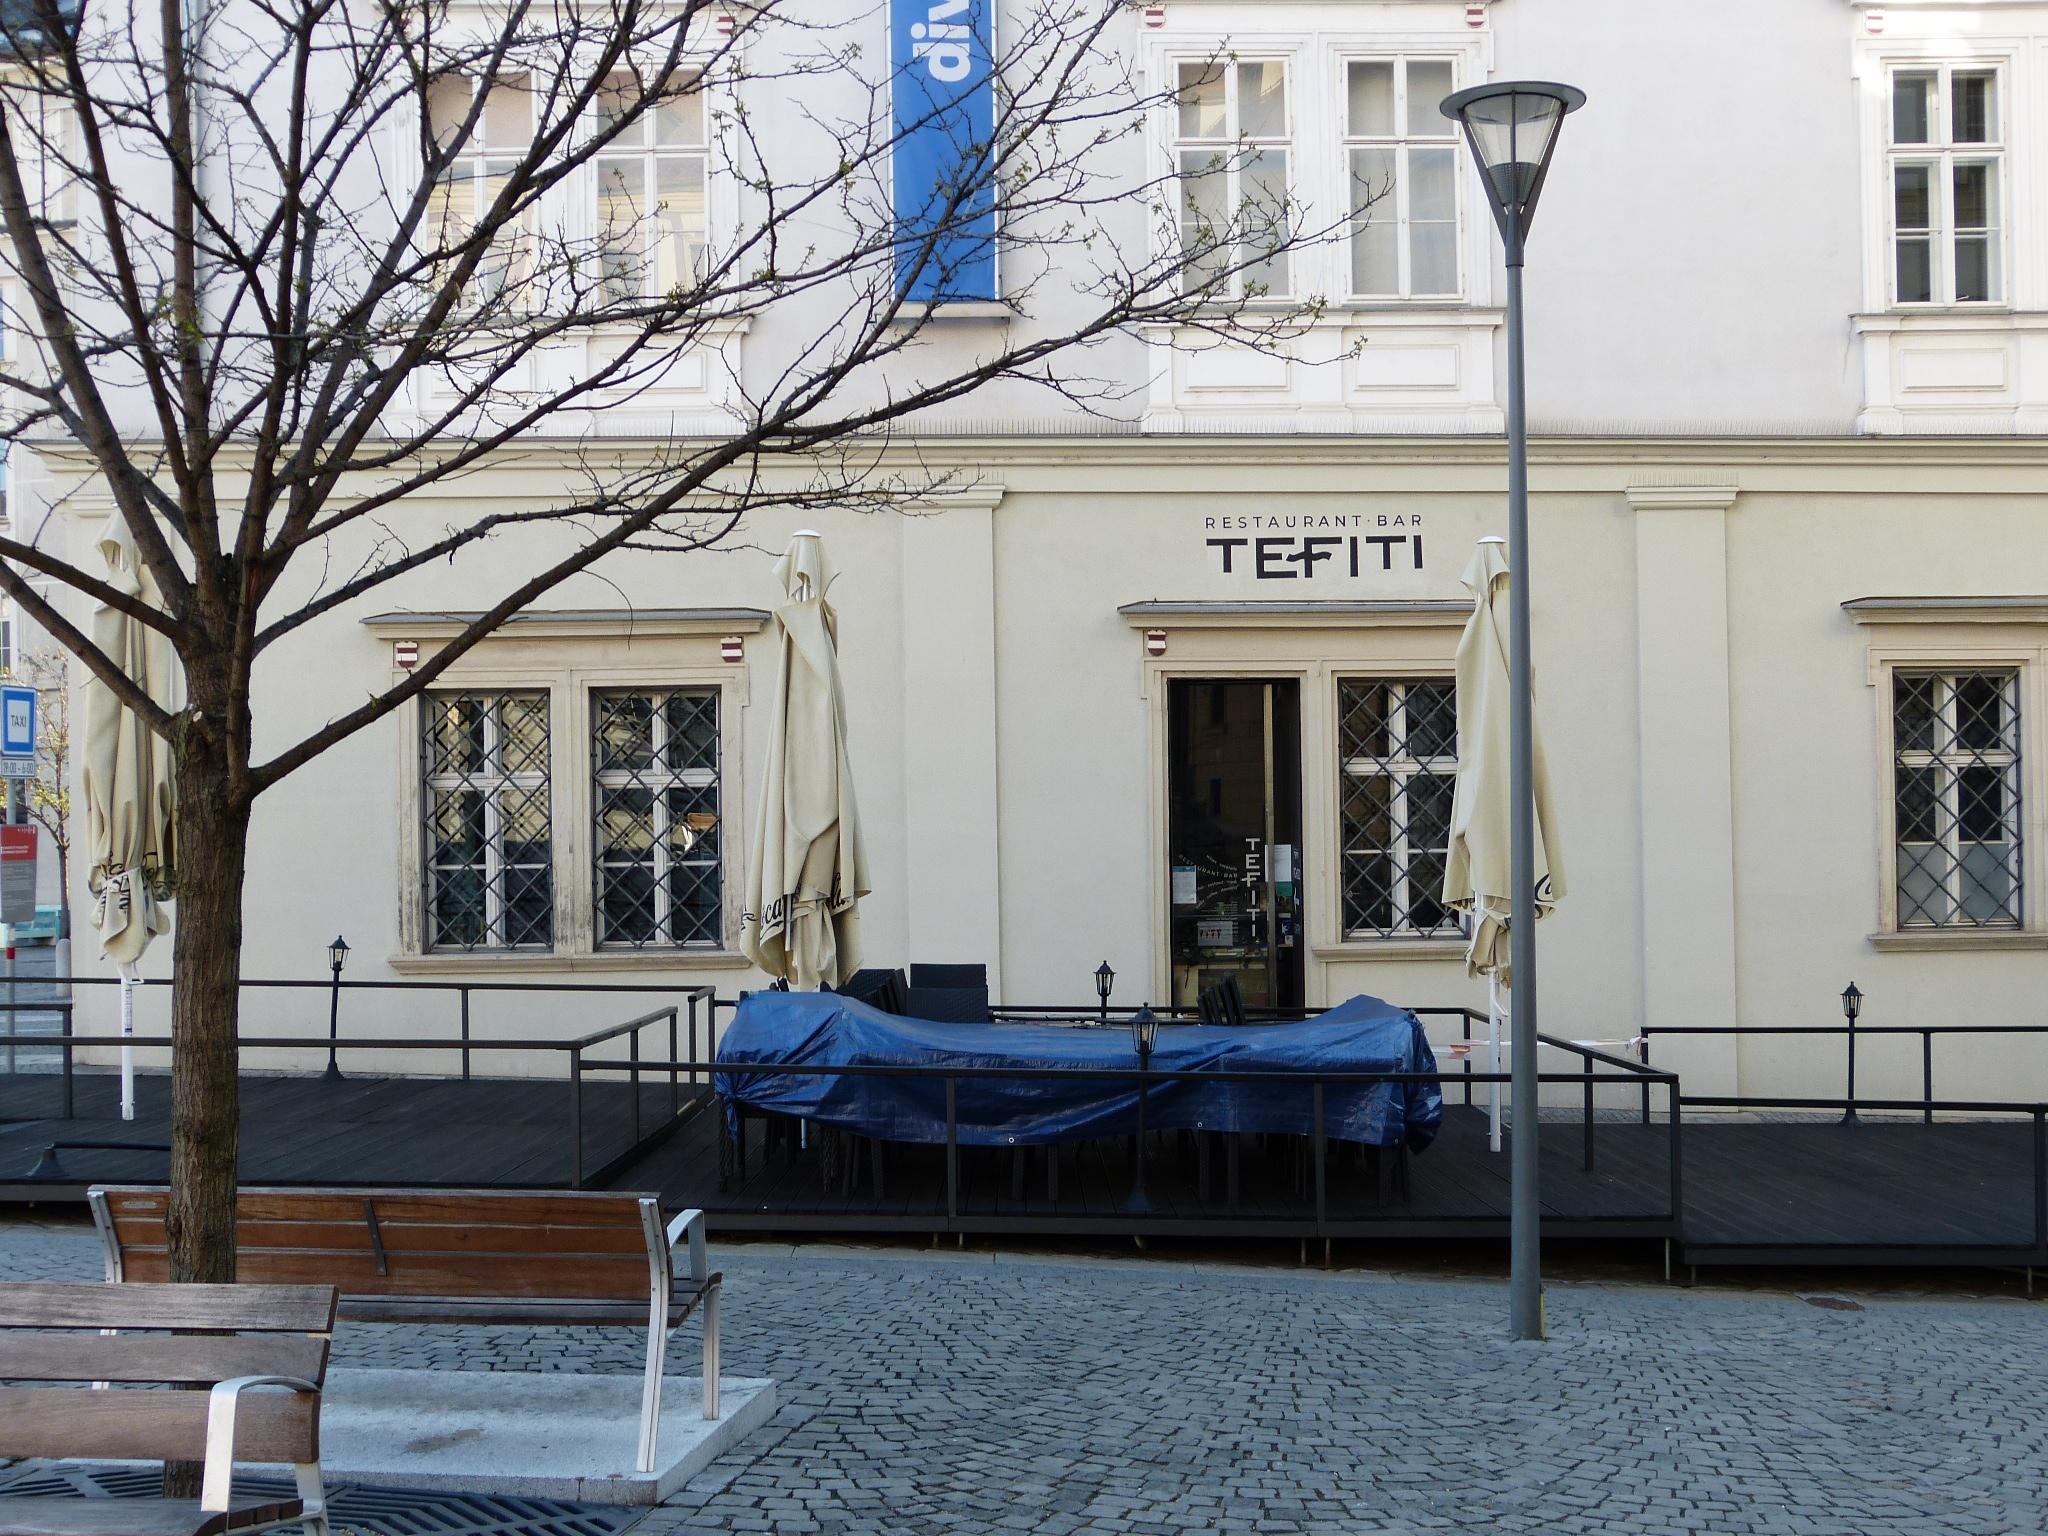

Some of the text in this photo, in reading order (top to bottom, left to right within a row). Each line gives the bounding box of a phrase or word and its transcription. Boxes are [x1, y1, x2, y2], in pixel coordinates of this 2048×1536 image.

[1205, 514, 1422, 529] RESTAURANT BAR
[1206, 535, 1424, 579] TEFITI
[10, 714, 27, 728] TAXI
[1240, 837, 1261, 937] TEFITI
